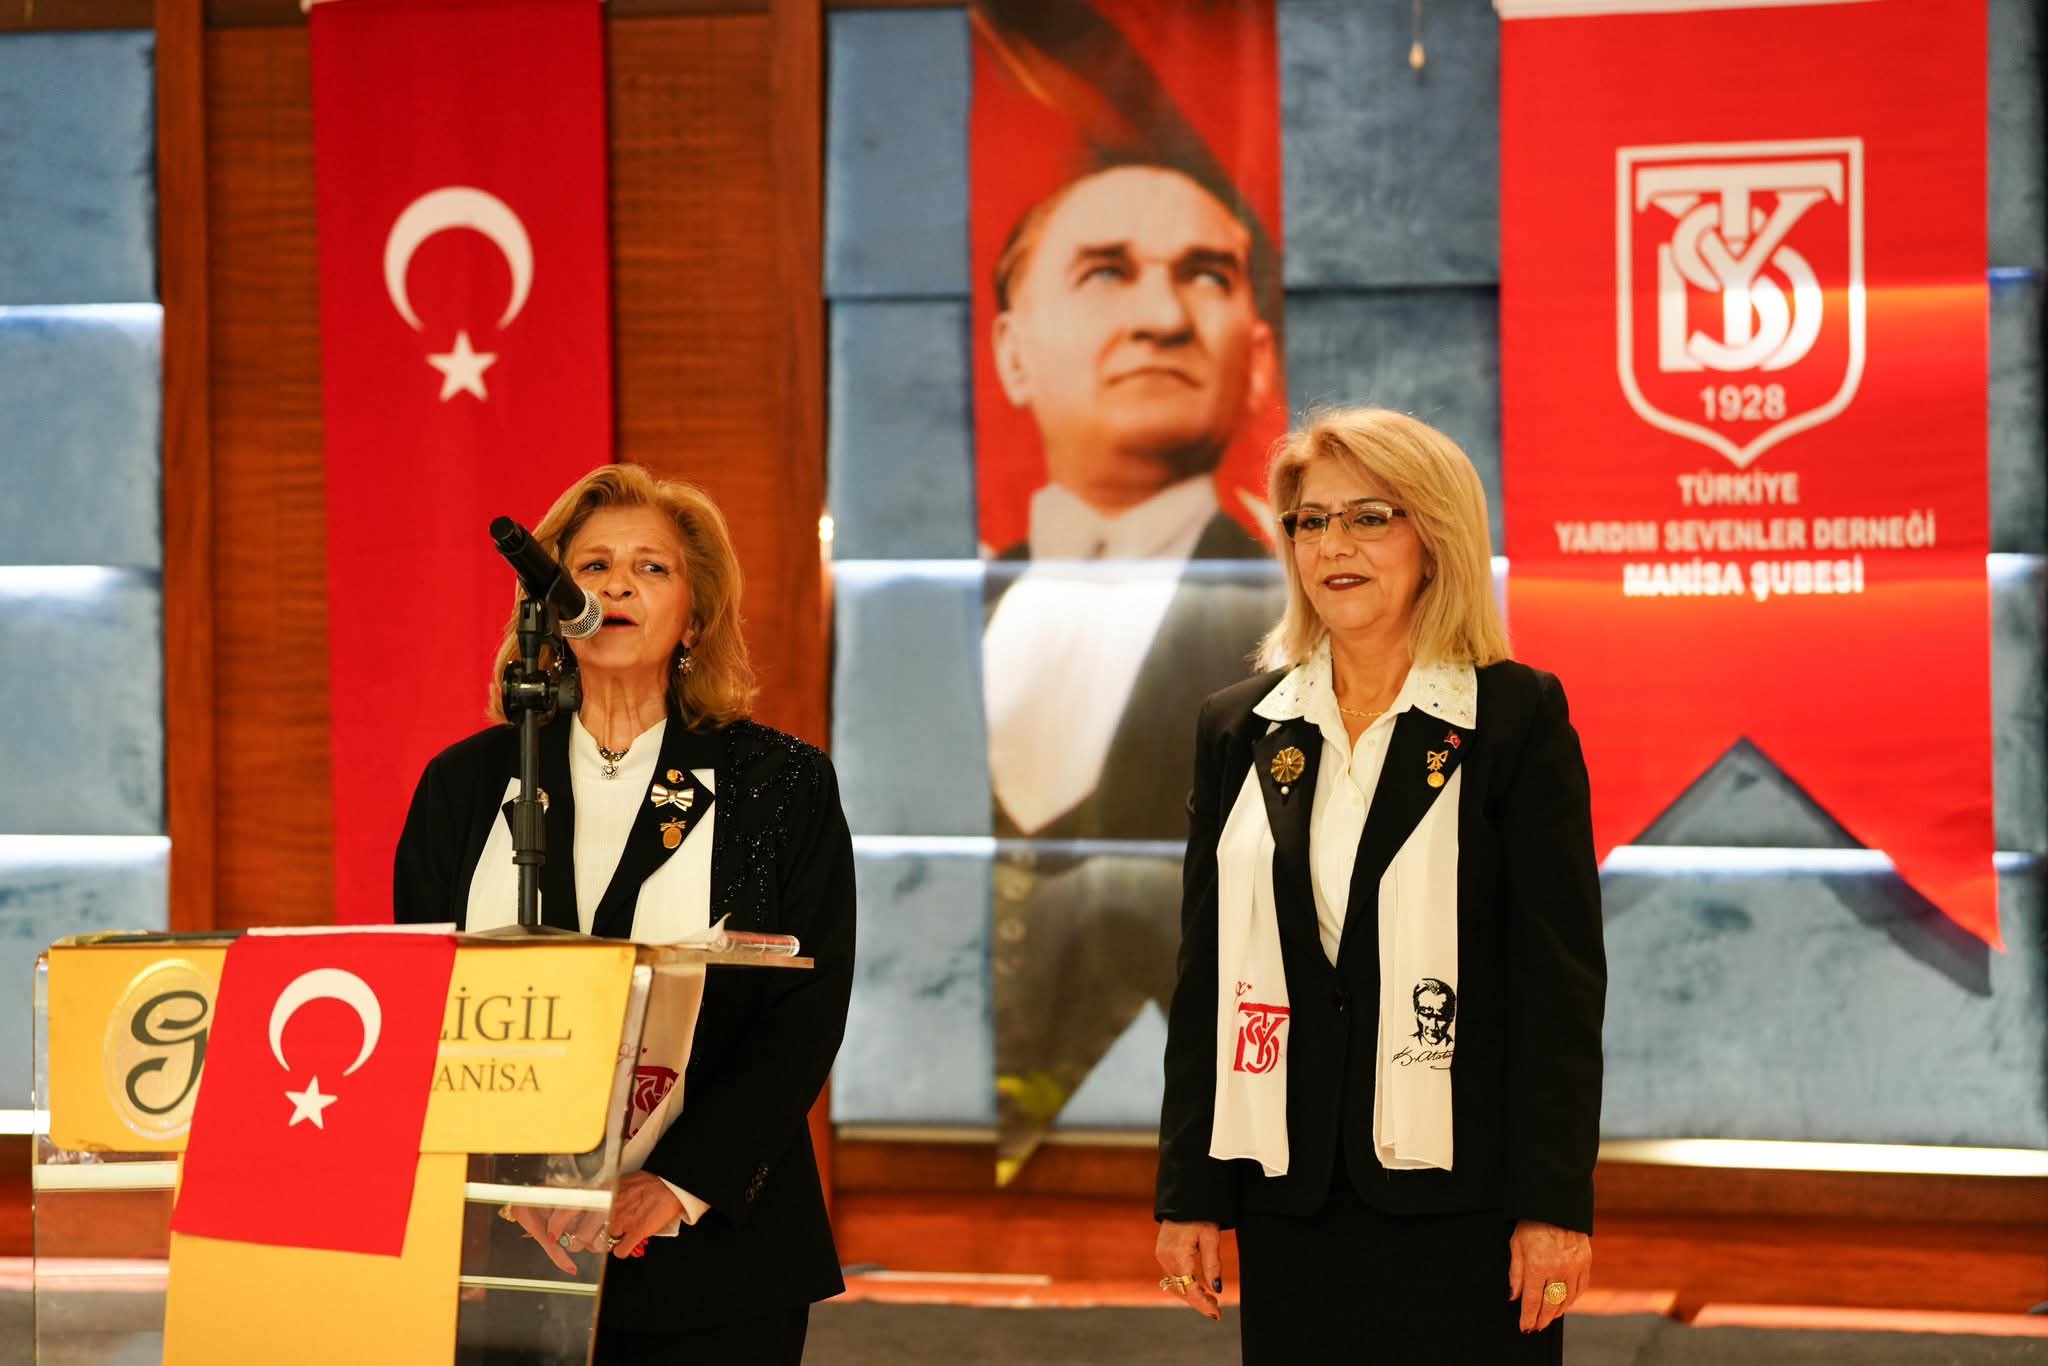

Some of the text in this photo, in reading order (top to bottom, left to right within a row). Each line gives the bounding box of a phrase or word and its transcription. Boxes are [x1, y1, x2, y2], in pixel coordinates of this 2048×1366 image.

[1700, 384, 1787, 422] 1928
[1677, 468, 1799, 505] TÜRKİYE
[1555, 509, 1936, 553] YARDIM SEVENLER DERNEĞİ
[1622, 554, 1865, 602] MANİSA ŞUBESİ
[440, 985, 572, 1042] İGİL
[433, 1058, 541, 1092] ANİSA
